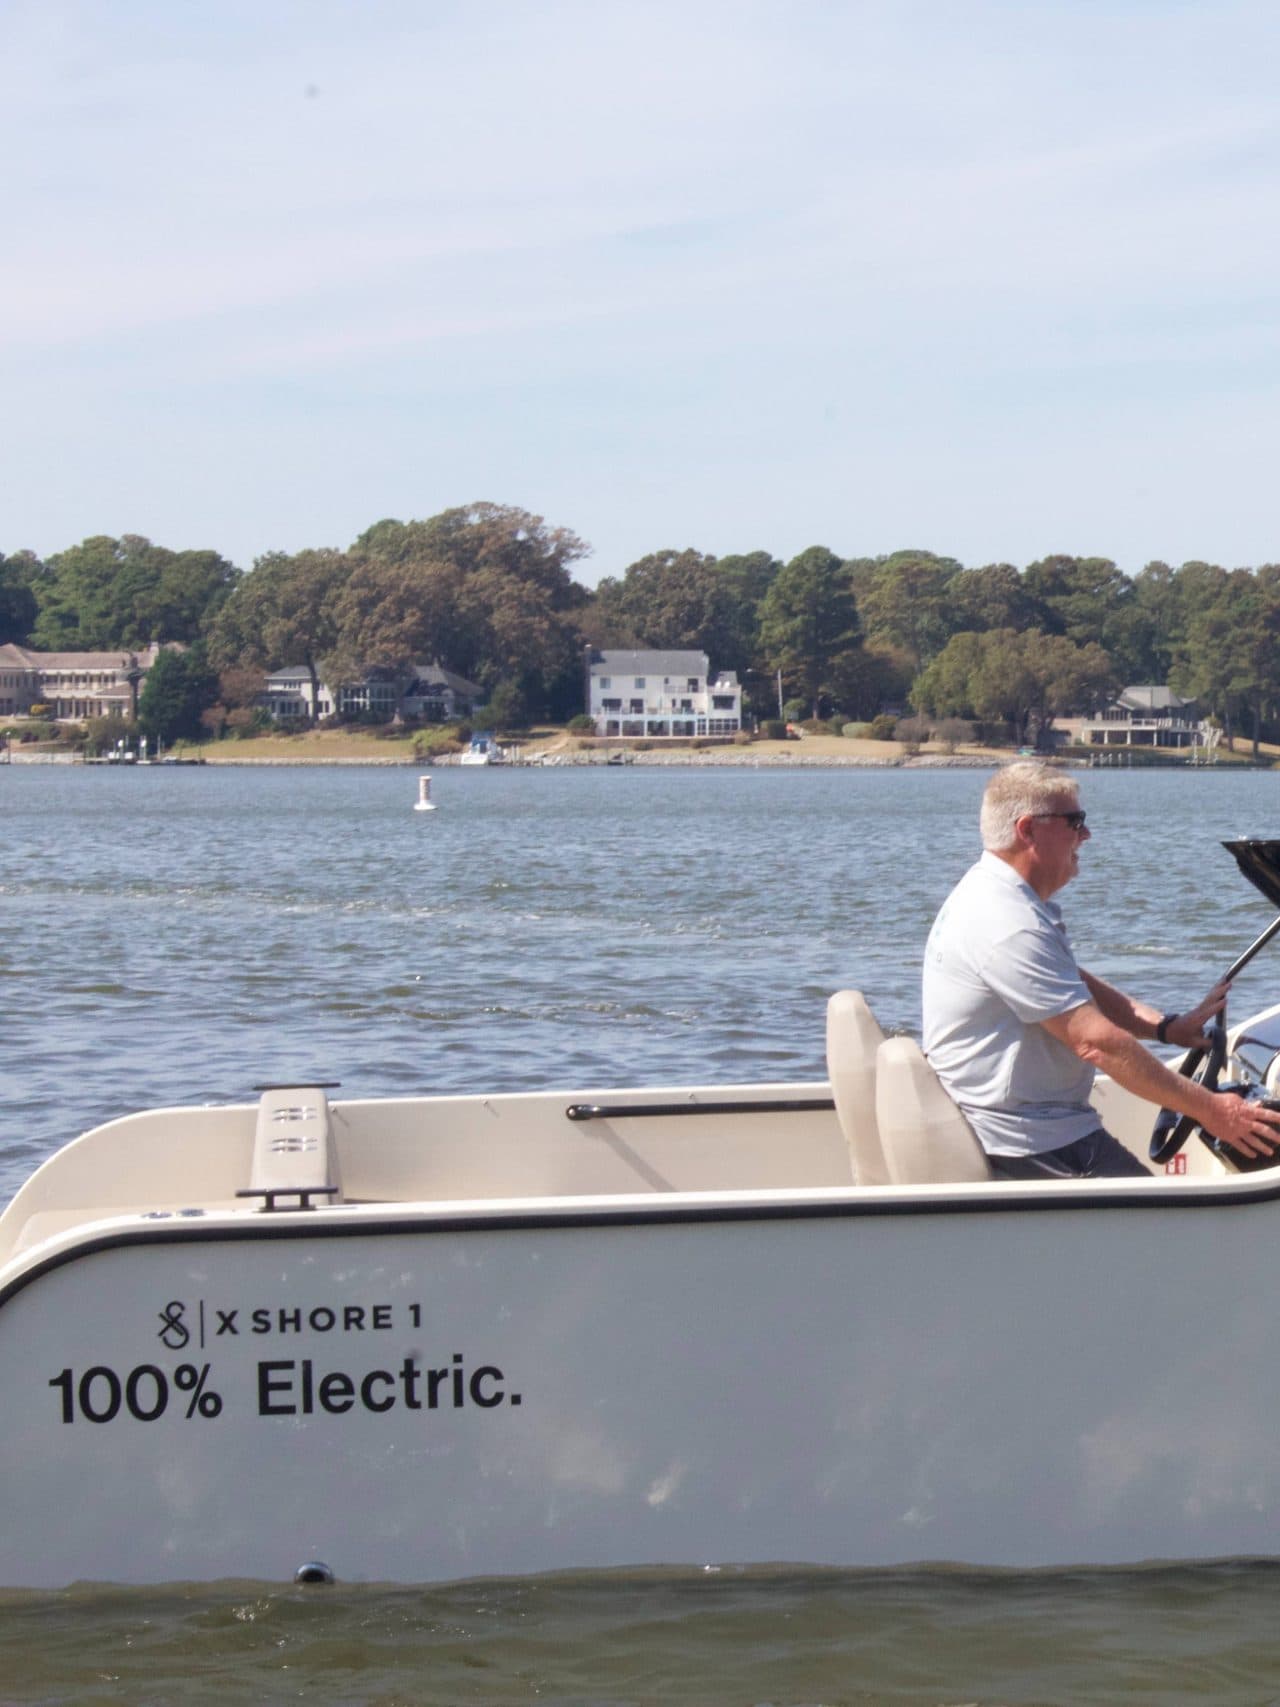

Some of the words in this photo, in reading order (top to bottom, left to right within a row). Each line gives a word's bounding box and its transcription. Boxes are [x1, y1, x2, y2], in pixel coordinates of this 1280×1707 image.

[214, 1309, 240, 1336] X
[251, 1304, 394, 1334] SHORE
[408, 1303, 422, 1329] 1
[48, 1361, 224, 1425] 100%
[256, 1352, 523, 1417] Electric.
